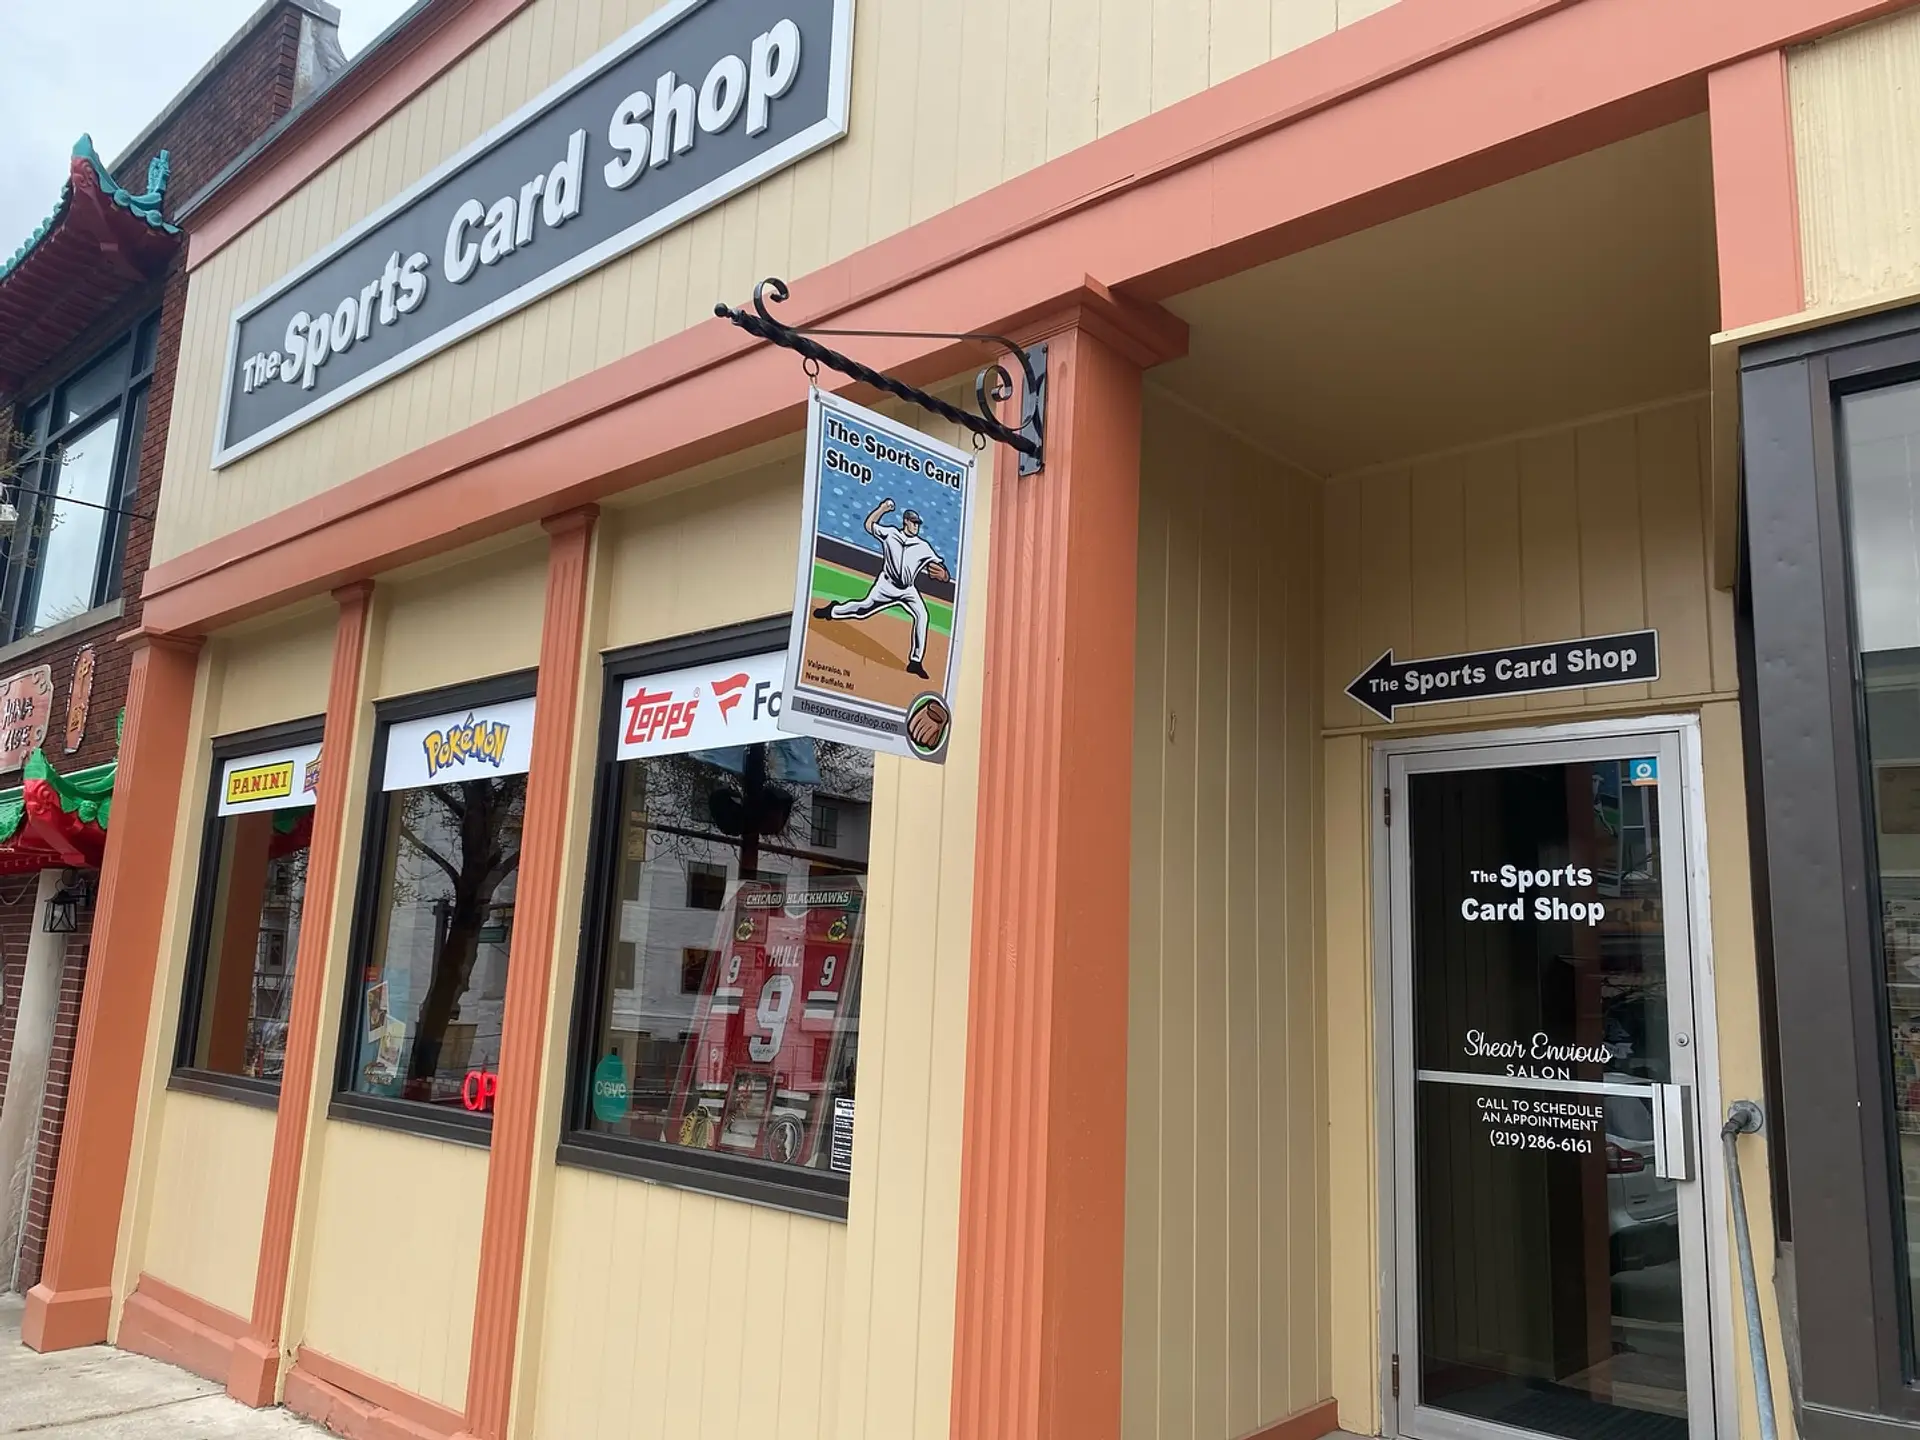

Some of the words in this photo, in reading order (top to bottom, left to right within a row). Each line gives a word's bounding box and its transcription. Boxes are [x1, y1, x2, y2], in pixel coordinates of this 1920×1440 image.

[242, 347, 281, 394] The
[281, 250, 428, 391] Sports
[443, 128, 586, 285] Card
[604, 16, 801, 191] Shop
[825, 449, 873, 485] Shop
[827, 417, 860, 447] The
[864, 434, 921, 472] Sports
[924, 460, 961, 490] Card
[805, 672, 819, 682] New
[820, 675, 845, 689] Buffalo,
[845, 681, 855, 690] MI
[1369, 678, 1399, 693] The
[1404, 664, 1486, 694] Sports
[1495, 653, 1557, 681] Card
[1567, 647, 1637, 673] Shop
[0, 697, 34, 731] HINA
[801, 700, 899, 732] thesportscardshop.com
[231, 769, 288, 796] PANINI
[1470, 870, 1498, 883] The
[1500, 863, 1592, 892] Sports
[746, 894, 782, 906] CHICAGO
[785, 891, 850, 905] BLACKHAWKS
[1461, 898, 1524, 921] Card
[1534, 897, 1605, 926] Shop
[726, 955, 742, 984] 9
[768, 945, 801, 967] HULL
[820, 956, 837, 986] 9
[749, 974, 795, 1063] 9
[1464, 1030, 1526, 1059] Shear
[1530, 1032, 1613, 1064] Envious
[1506, 1064, 1571, 1080] SALON
[462, 1070, 498, 1111] OP
[1477, 1097, 1508, 1111] CALL
[1512, 1100, 1530, 1112] TO
[1533, 1101, 1603, 1118] SCHEDULE
[1482, 1112, 1500, 1123] AN
[1504, 1113, 1598, 1132] APPOINTMENT
